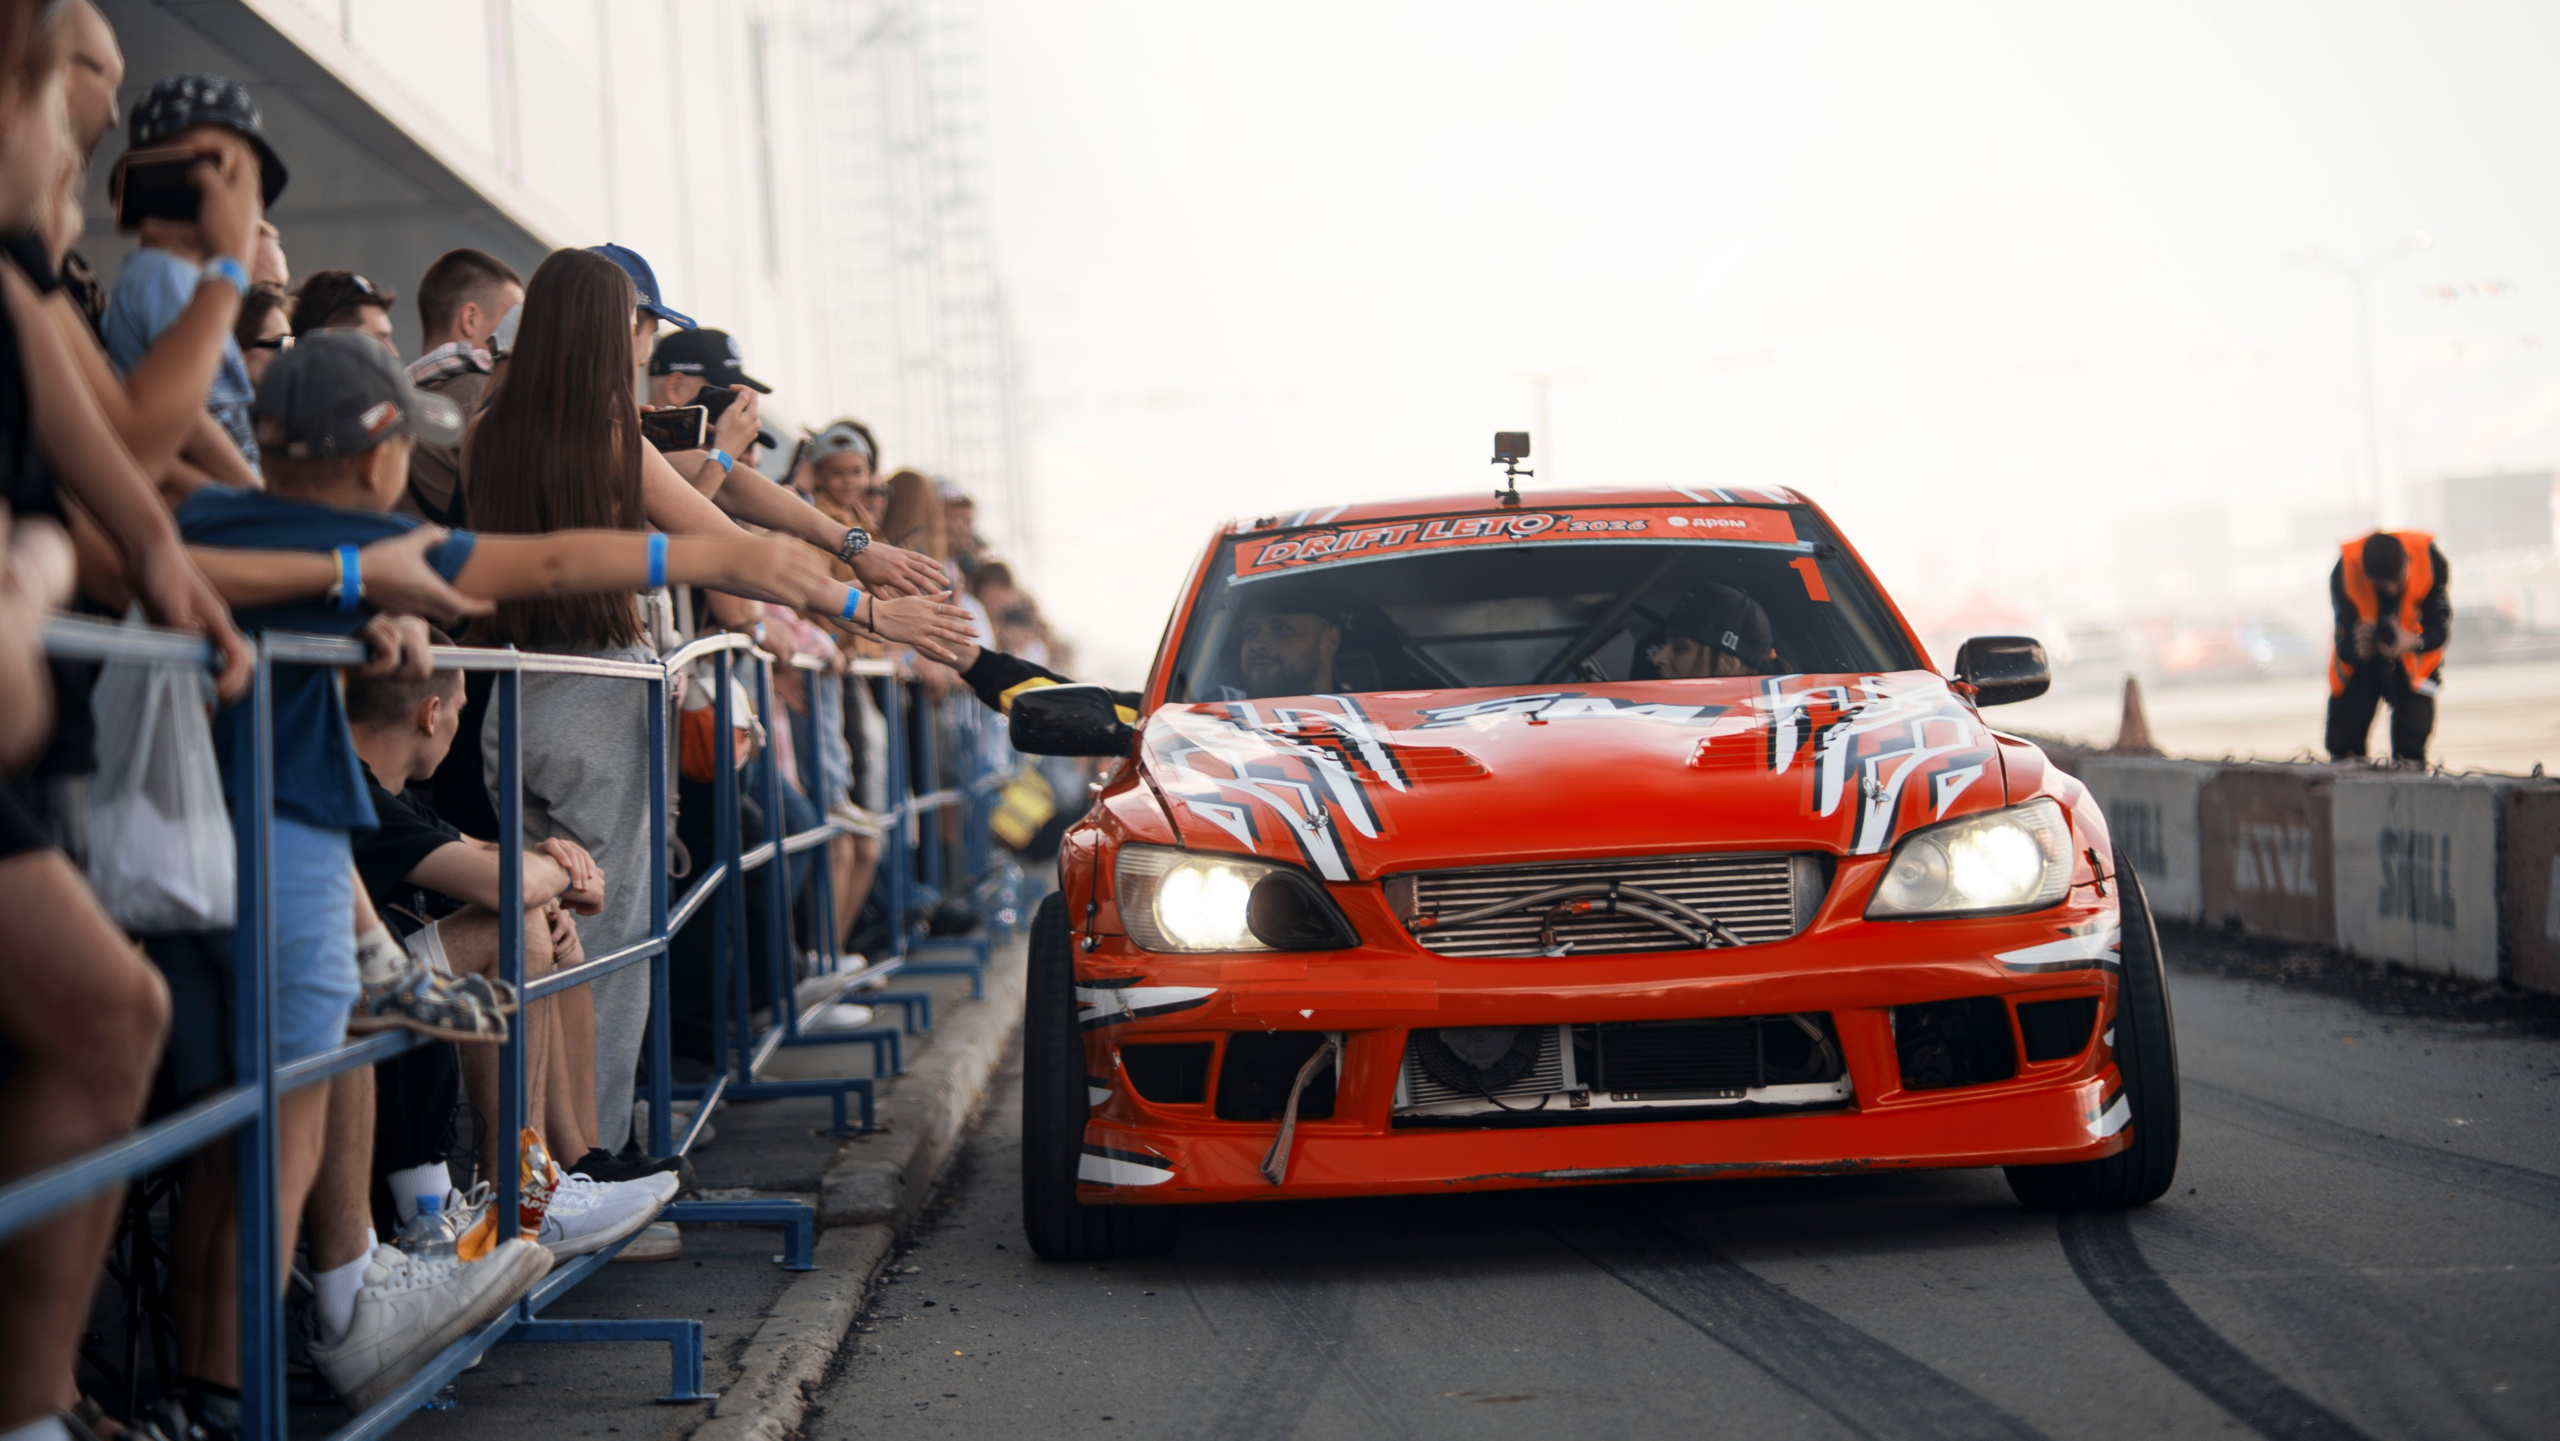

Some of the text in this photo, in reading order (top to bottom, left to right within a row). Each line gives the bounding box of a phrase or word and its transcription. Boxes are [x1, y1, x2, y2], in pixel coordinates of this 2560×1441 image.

[1254, 512, 1649, 566] DRIFT LETO 2026
[1788, 556, 1831, 602] 1
